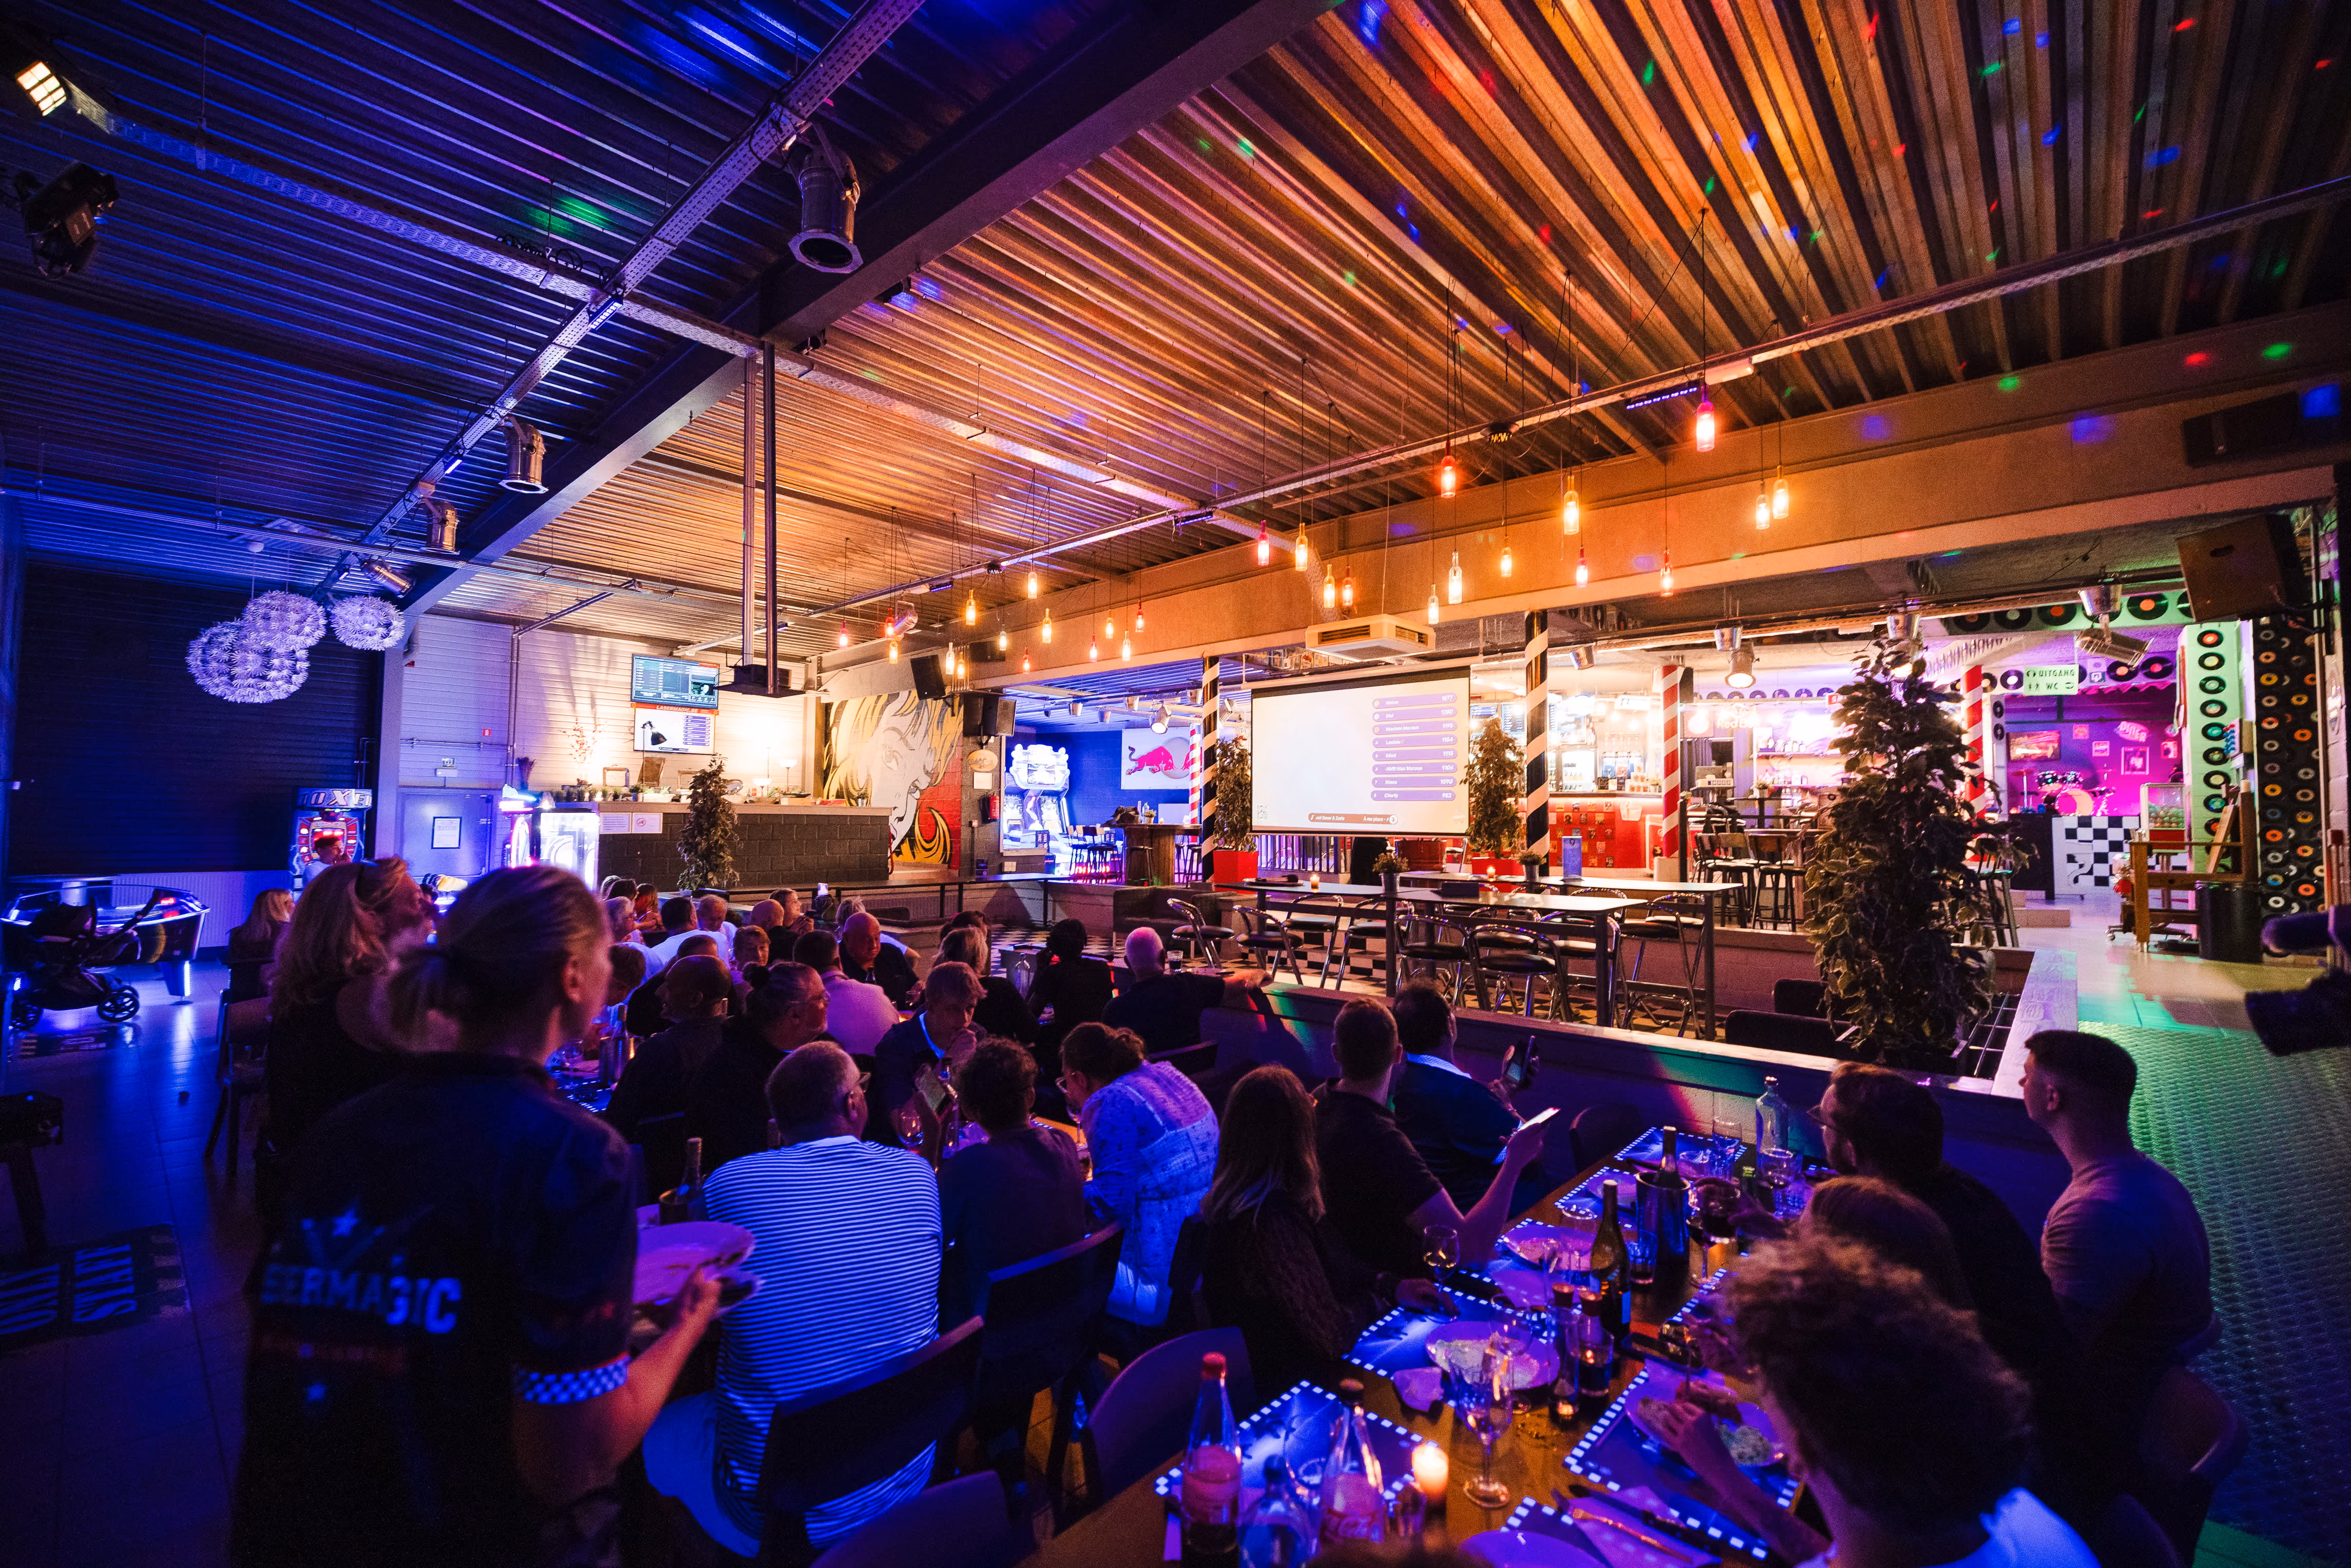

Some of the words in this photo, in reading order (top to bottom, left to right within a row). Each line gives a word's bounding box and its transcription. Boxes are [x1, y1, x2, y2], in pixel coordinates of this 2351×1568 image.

[656, 705, 698, 713] LASERMAGIC.BE
[2120, 721, 2147, 743] DINER
[72, 1244, 138, 1323] STAFF
